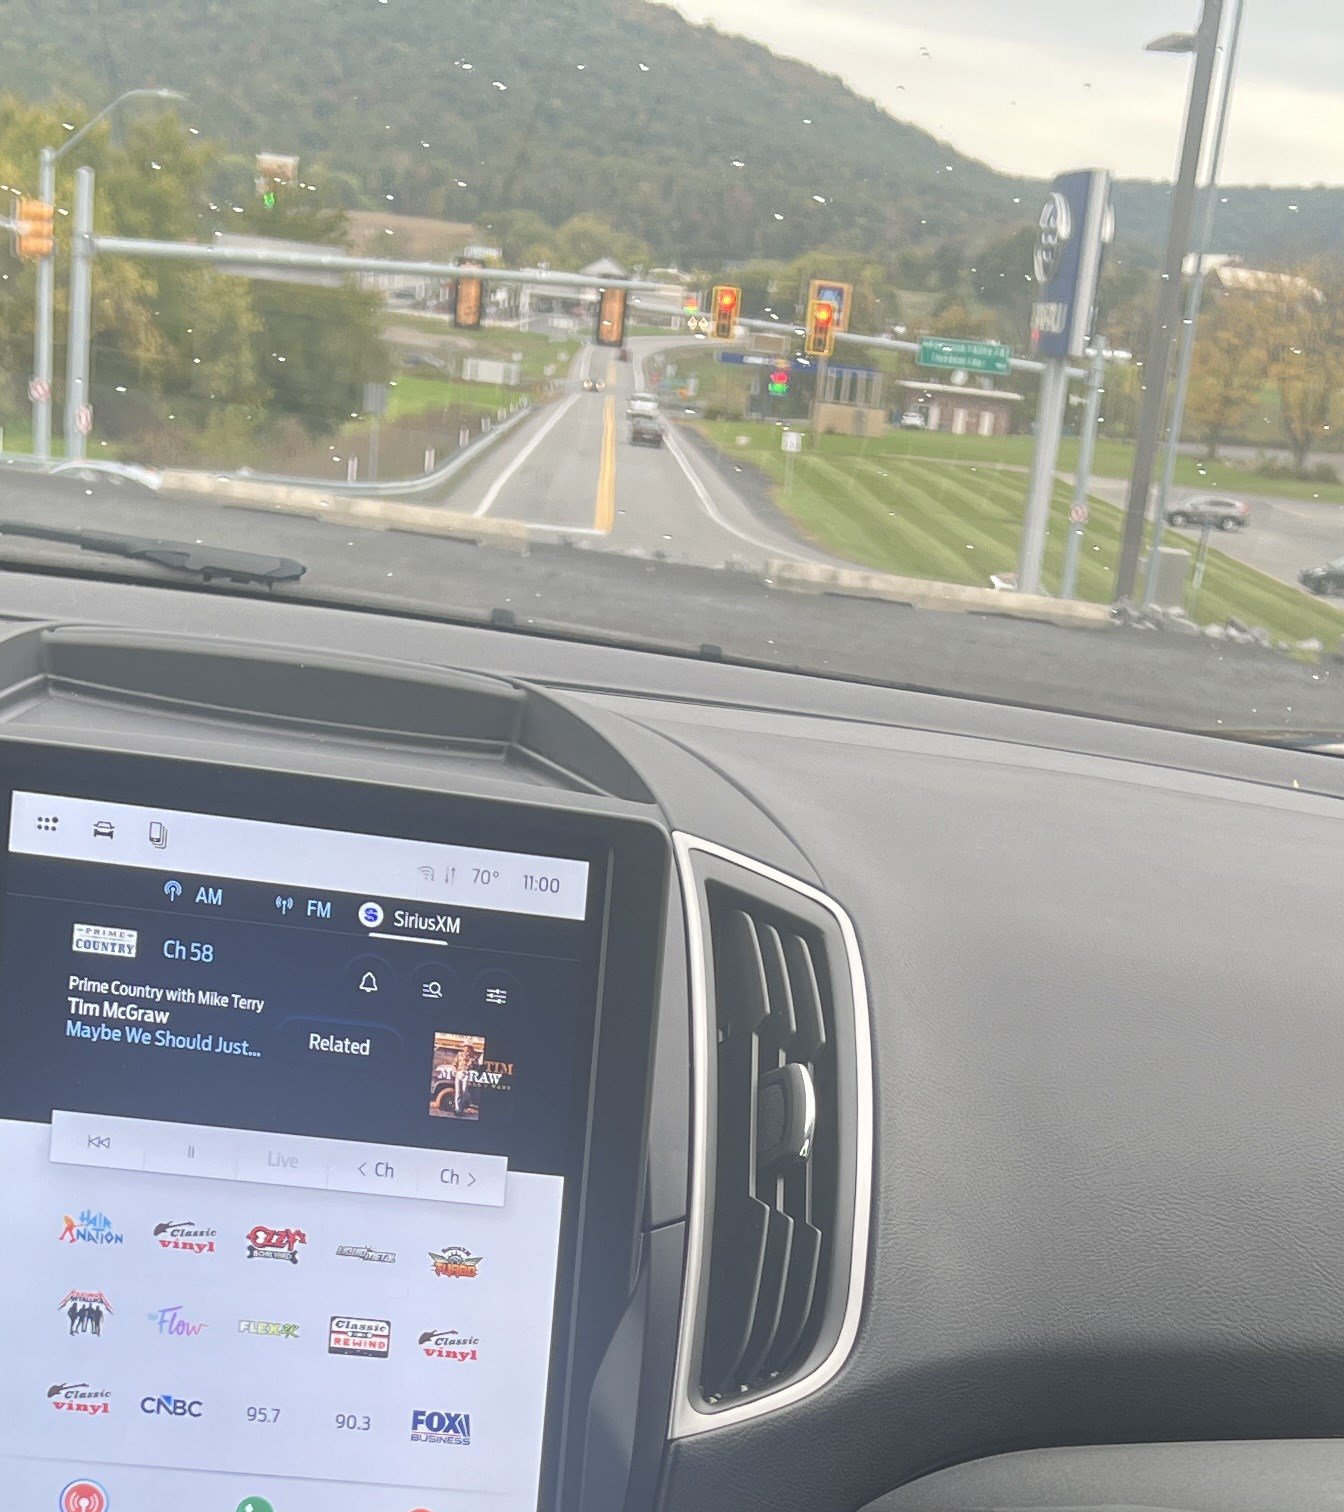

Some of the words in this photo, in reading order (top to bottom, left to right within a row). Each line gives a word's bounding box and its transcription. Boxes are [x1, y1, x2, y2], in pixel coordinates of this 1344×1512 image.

[522, 873, 561, 894] 11:00
[195, 886, 224, 906] AM
[306, 899, 332, 919] FM
[393, 910, 462, 934] SiriusXM
[85, 926, 126, 938] PRIME
[75, 937, 135, 956] COUNTRY
[163, 939, 186, 960] Ch
[190, 942, 214, 963] 58
[68, 975, 109, 995] Prime
[111, 980, 164, 1002] Country
[165, 987, 195, 1004] with
[198, 990, 229, 1008] Mike
[231, 993, 265, 1013] Terry
[67, 996, 100, 1017] Tim
[102, 1000, 170, 1024] McGraw
[65, 1019, 122, 1042] Maybe
[125, 1025, 151, 1045] We
[154, 1029, 213, 1052] Should
[308, 1032, 371, 1056] Related
[484, 1060, 514, 1075] TIM
[267, 1150, 299, 1169] Live
[374, 1161, 395, 1178] Ch
[439, 1168, 460, 1185] Ch
[78, 1209, 112, 1229] HAIR
[76, 1228, 124, 1245] NATION
[170, 1228, 218, 1238] Classic
[158, 1239, 216, 1254] vinyl
[335, 1319, 387, 1333] Classic
[333, 1337, 386, 1350] REWIND
[434, 1336, 480, 1346] Classic
[423, 1348, 478, 1362] vinyl
[64, 1388, 112, 1399] Classic
[52, 1400, 111, 1415] vinyl
[140, 1395, 204, 1417] CNBC
[246, 1406, 282, 1424] 95.7
[335, 1413, 371, 1431] 90.3
[412, 1409, 462, 1433] FOX
[410, 1432, 471, 1446] BUSINESS
